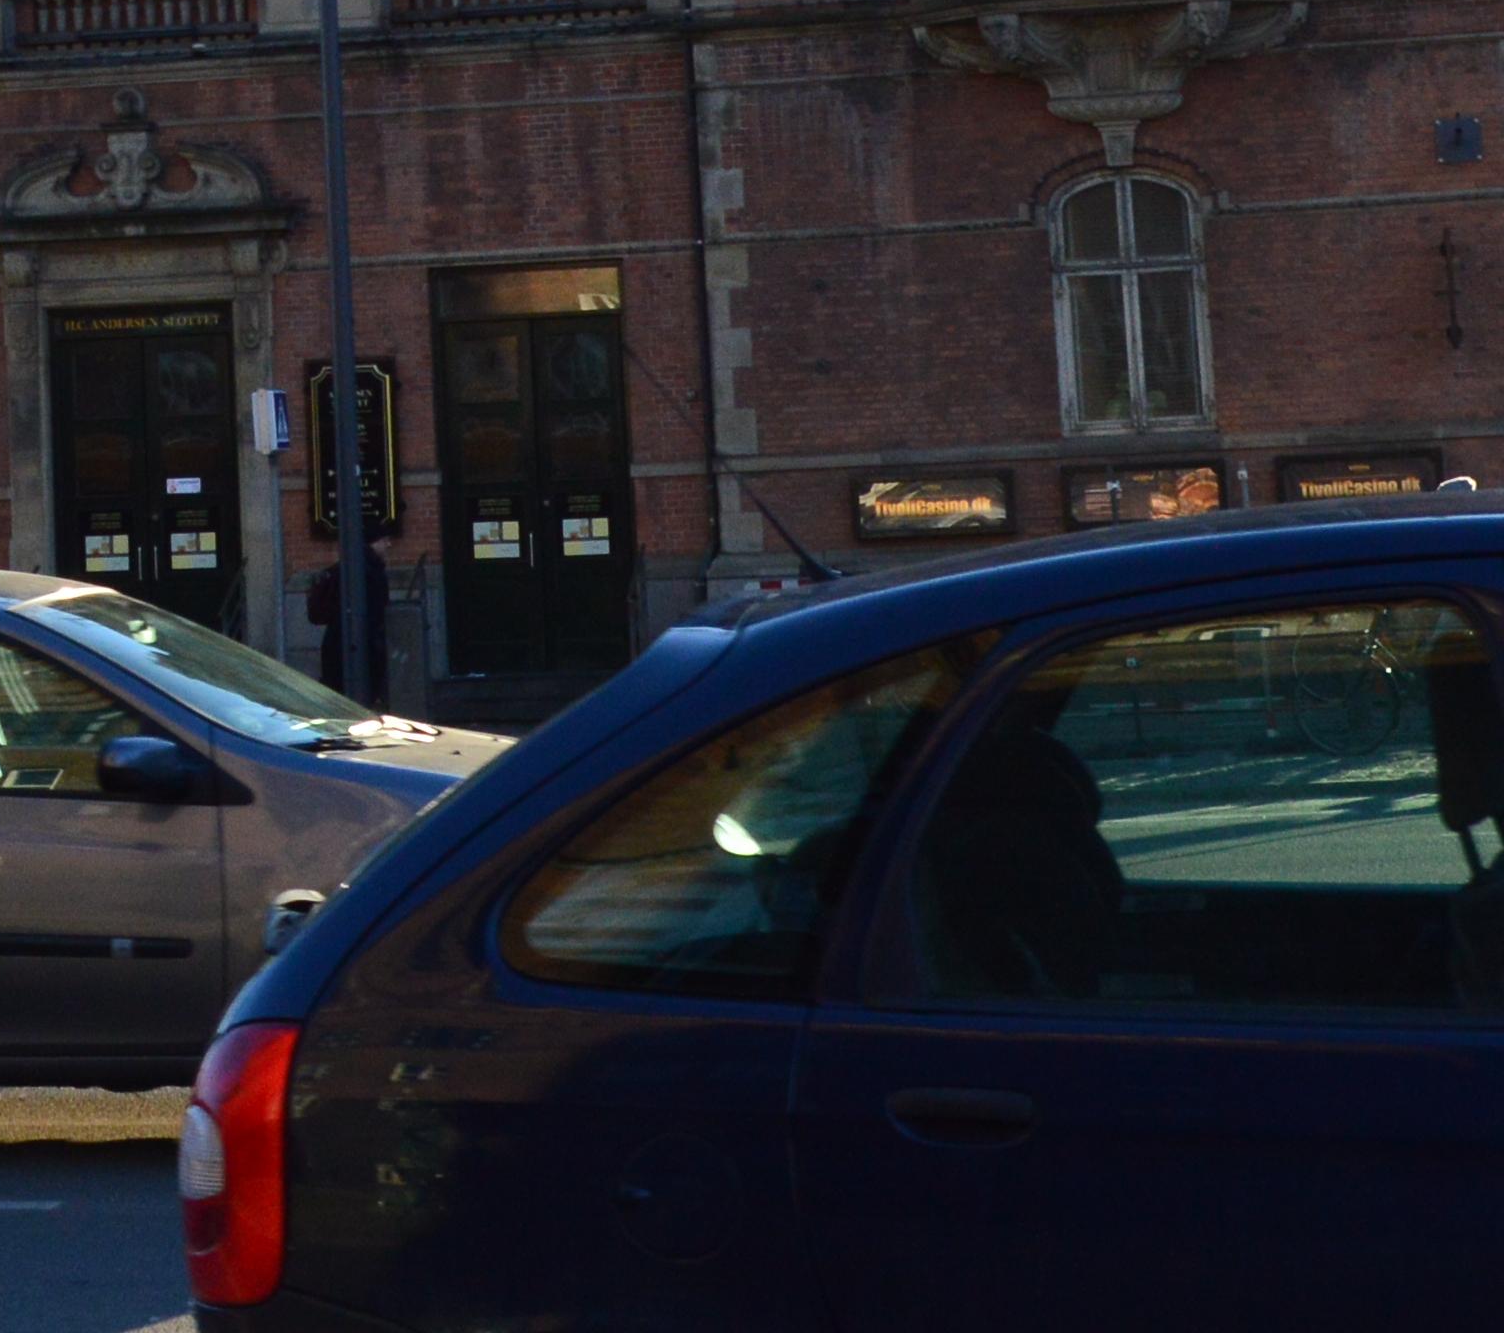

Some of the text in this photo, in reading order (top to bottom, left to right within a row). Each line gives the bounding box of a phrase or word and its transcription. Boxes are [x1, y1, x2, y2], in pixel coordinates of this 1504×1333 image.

[91, 315, 158, 332] ANDERSEN
[162, 311, 221, 327] SLOTTET
[874, 495, 992, 518] TivoliCasino.dk
